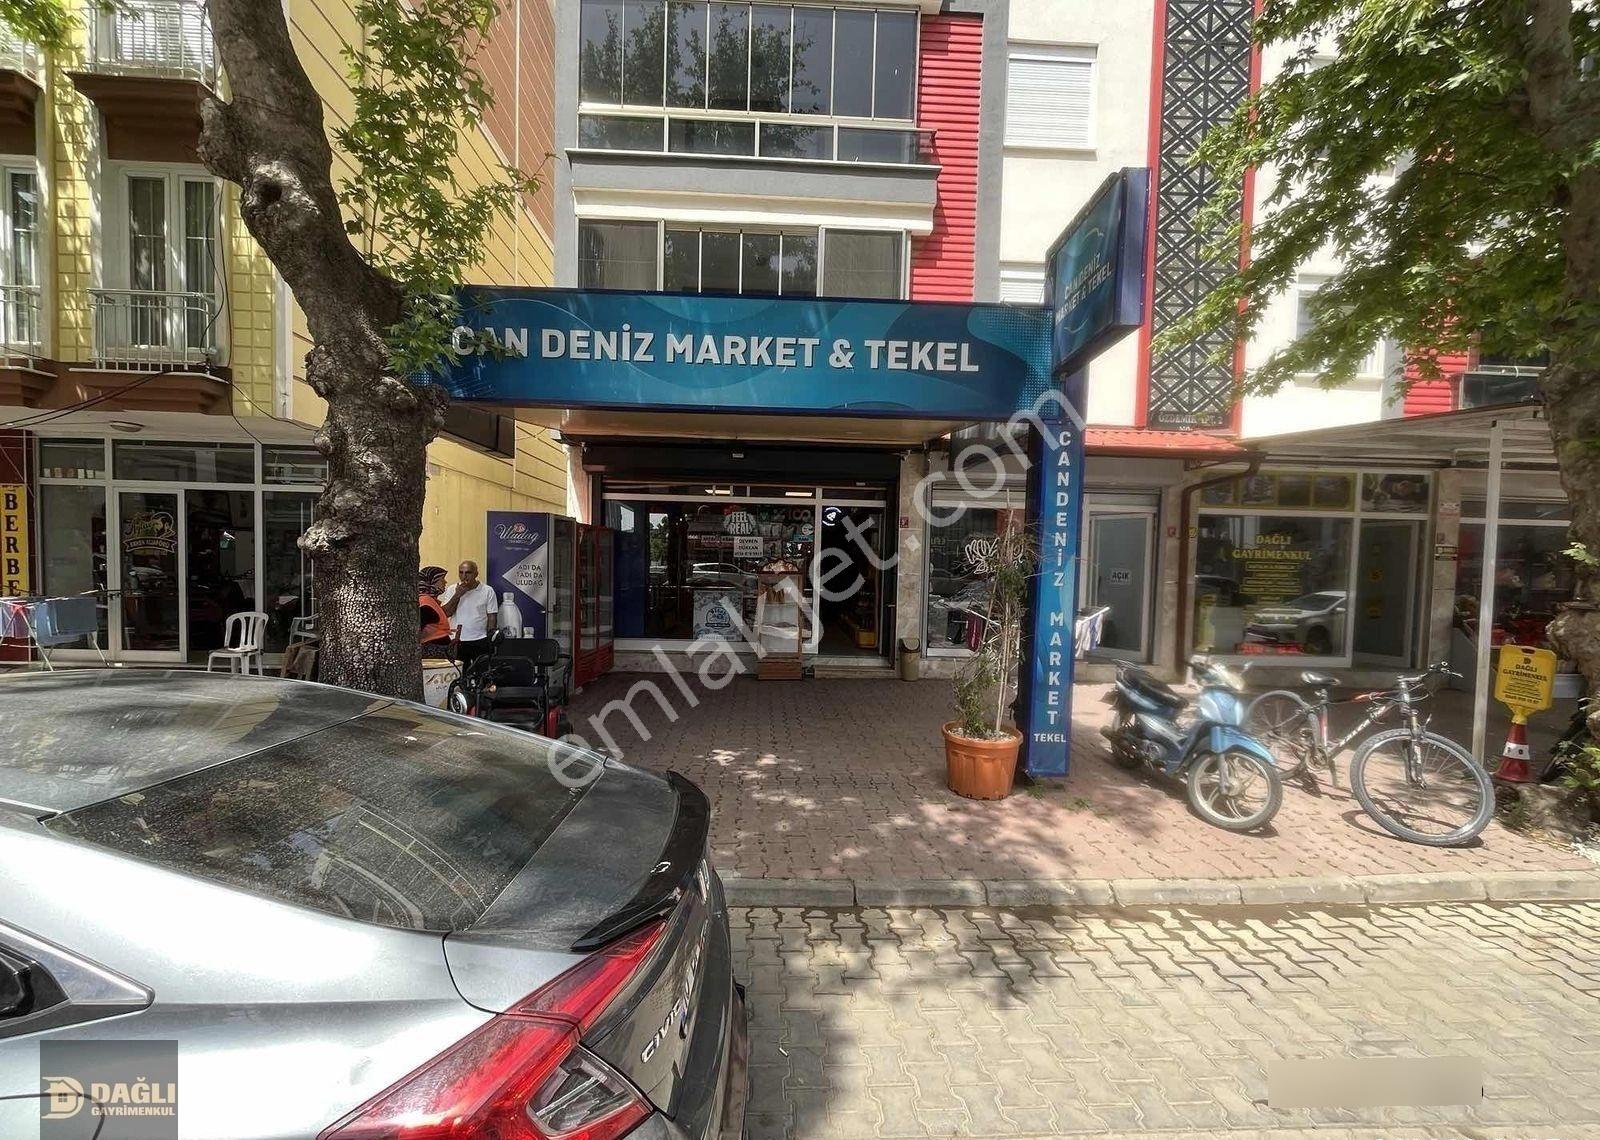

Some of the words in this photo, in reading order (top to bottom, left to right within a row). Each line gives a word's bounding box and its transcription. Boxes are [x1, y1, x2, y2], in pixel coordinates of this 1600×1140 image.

[1087, 261, 1112, 295] TEKEL
[541, 323, 655, 362] DENİZ
[666, 333, 820, 367] MARKET
[828, 339, 855, 369] &
[864, 339, 979, 372] TEKEL
[732, 511, 748, 523] FEEL
[730, 523, 752, 535] REAL
[1256, 533, 1292, 544] DAĞLI
[1232, 548, 1312, 560] GAYRİMENKUL
[1047, 612, 1064, 725] MARKET
[1034, 733, 1067, 743] TEKEL
